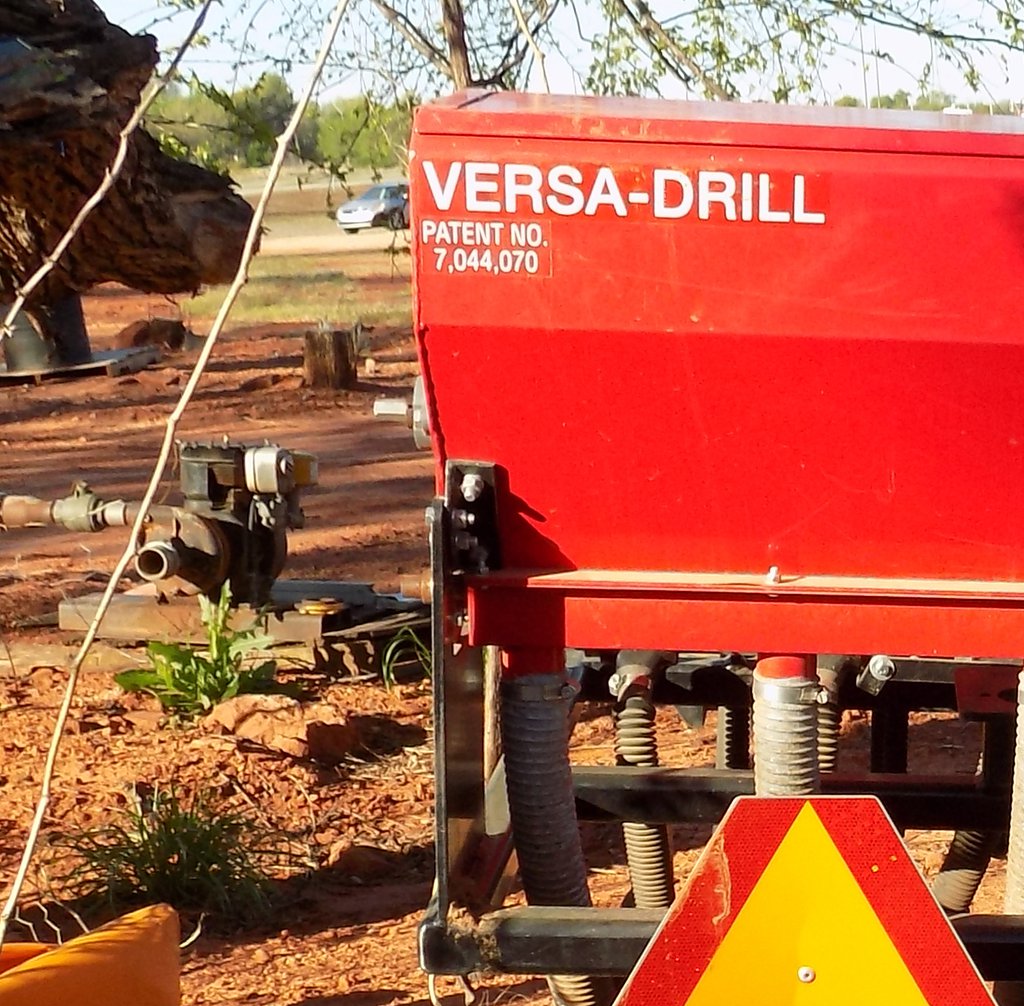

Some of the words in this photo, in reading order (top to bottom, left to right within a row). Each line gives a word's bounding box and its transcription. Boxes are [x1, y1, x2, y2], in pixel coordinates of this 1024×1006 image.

[422, 160, 826, 224] VERSA-DRILL
[422, 220, 504, 246] PATENT
[510, 222, 549, 248] NO.
[433, 247, 539, 275] 7,044,070
